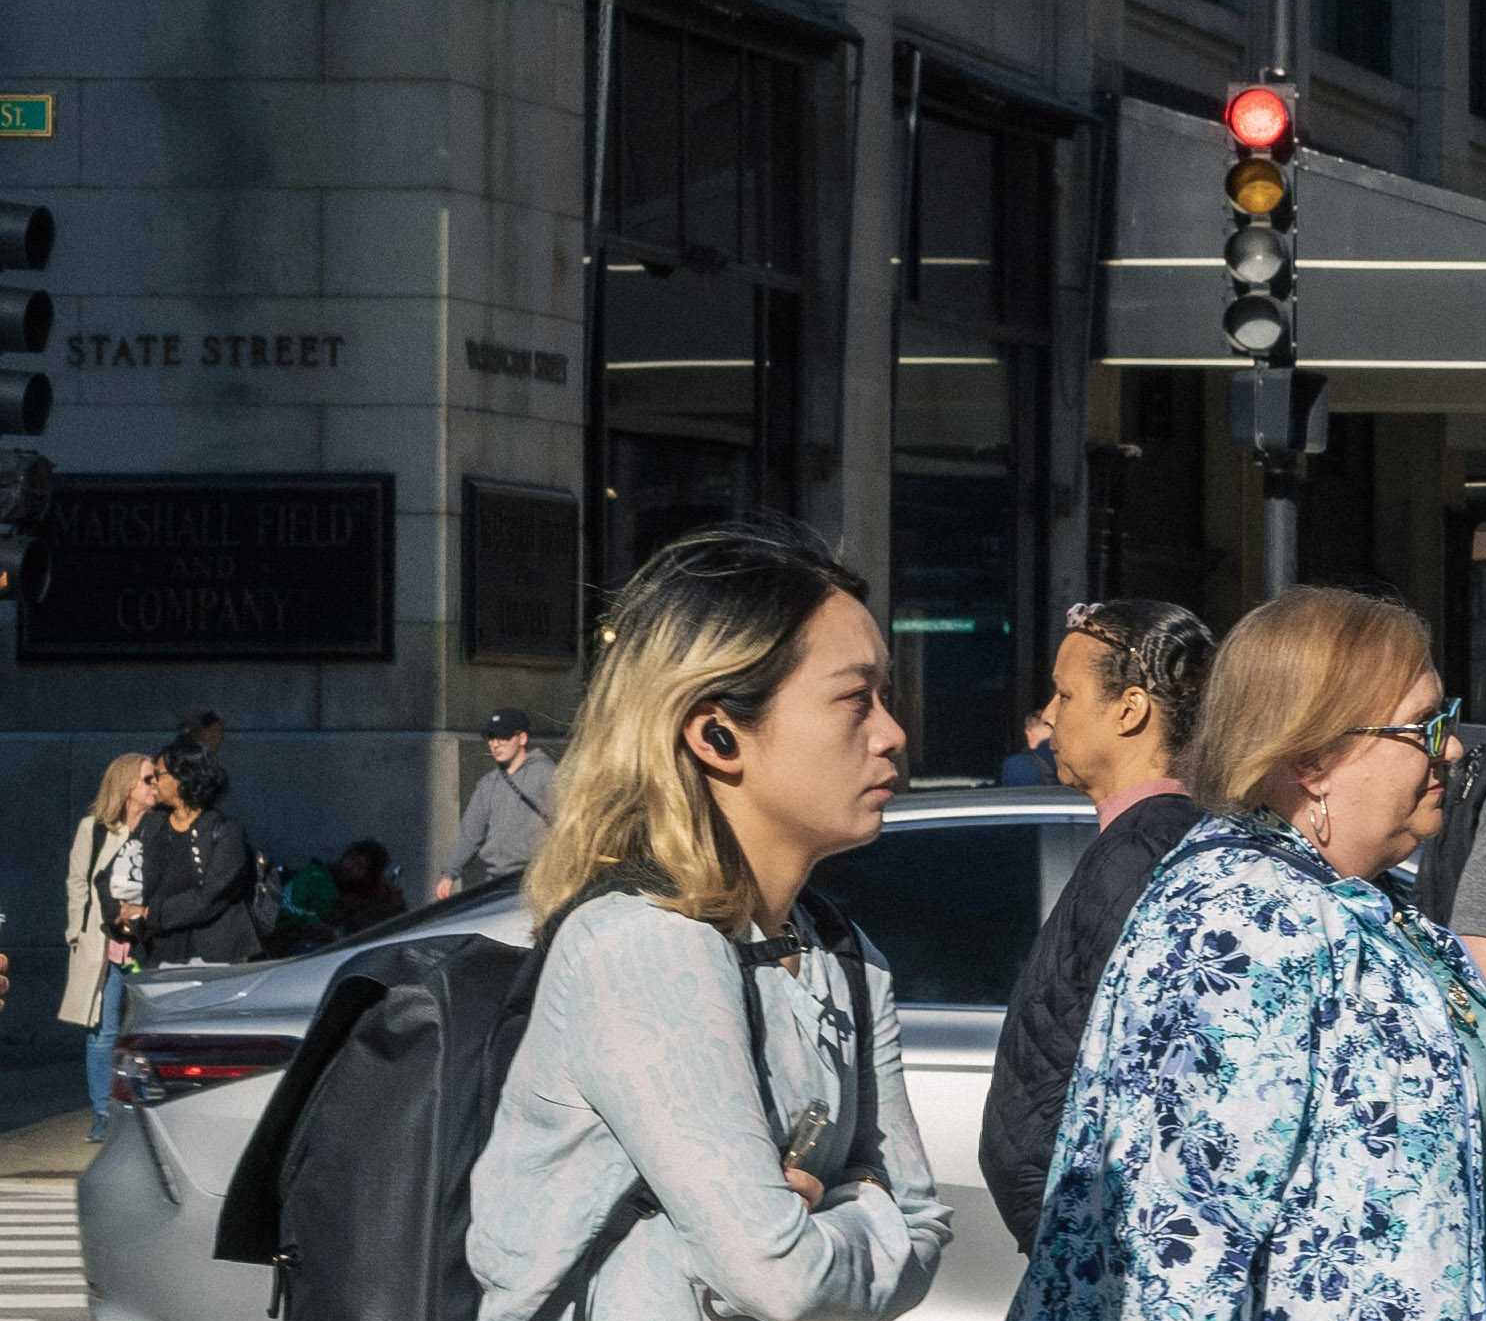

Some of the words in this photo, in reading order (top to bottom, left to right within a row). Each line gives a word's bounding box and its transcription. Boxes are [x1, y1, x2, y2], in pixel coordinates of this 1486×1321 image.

[67, 334, 182, 368] STATE
[201, 334, 345, 369] STREET
[51, 501, 241, 548] MARSHALL
[254, 501, 355, 548] FIELD
[170, 556, 238, 581] AND
[115, 589, 292, 634] COMPANY
